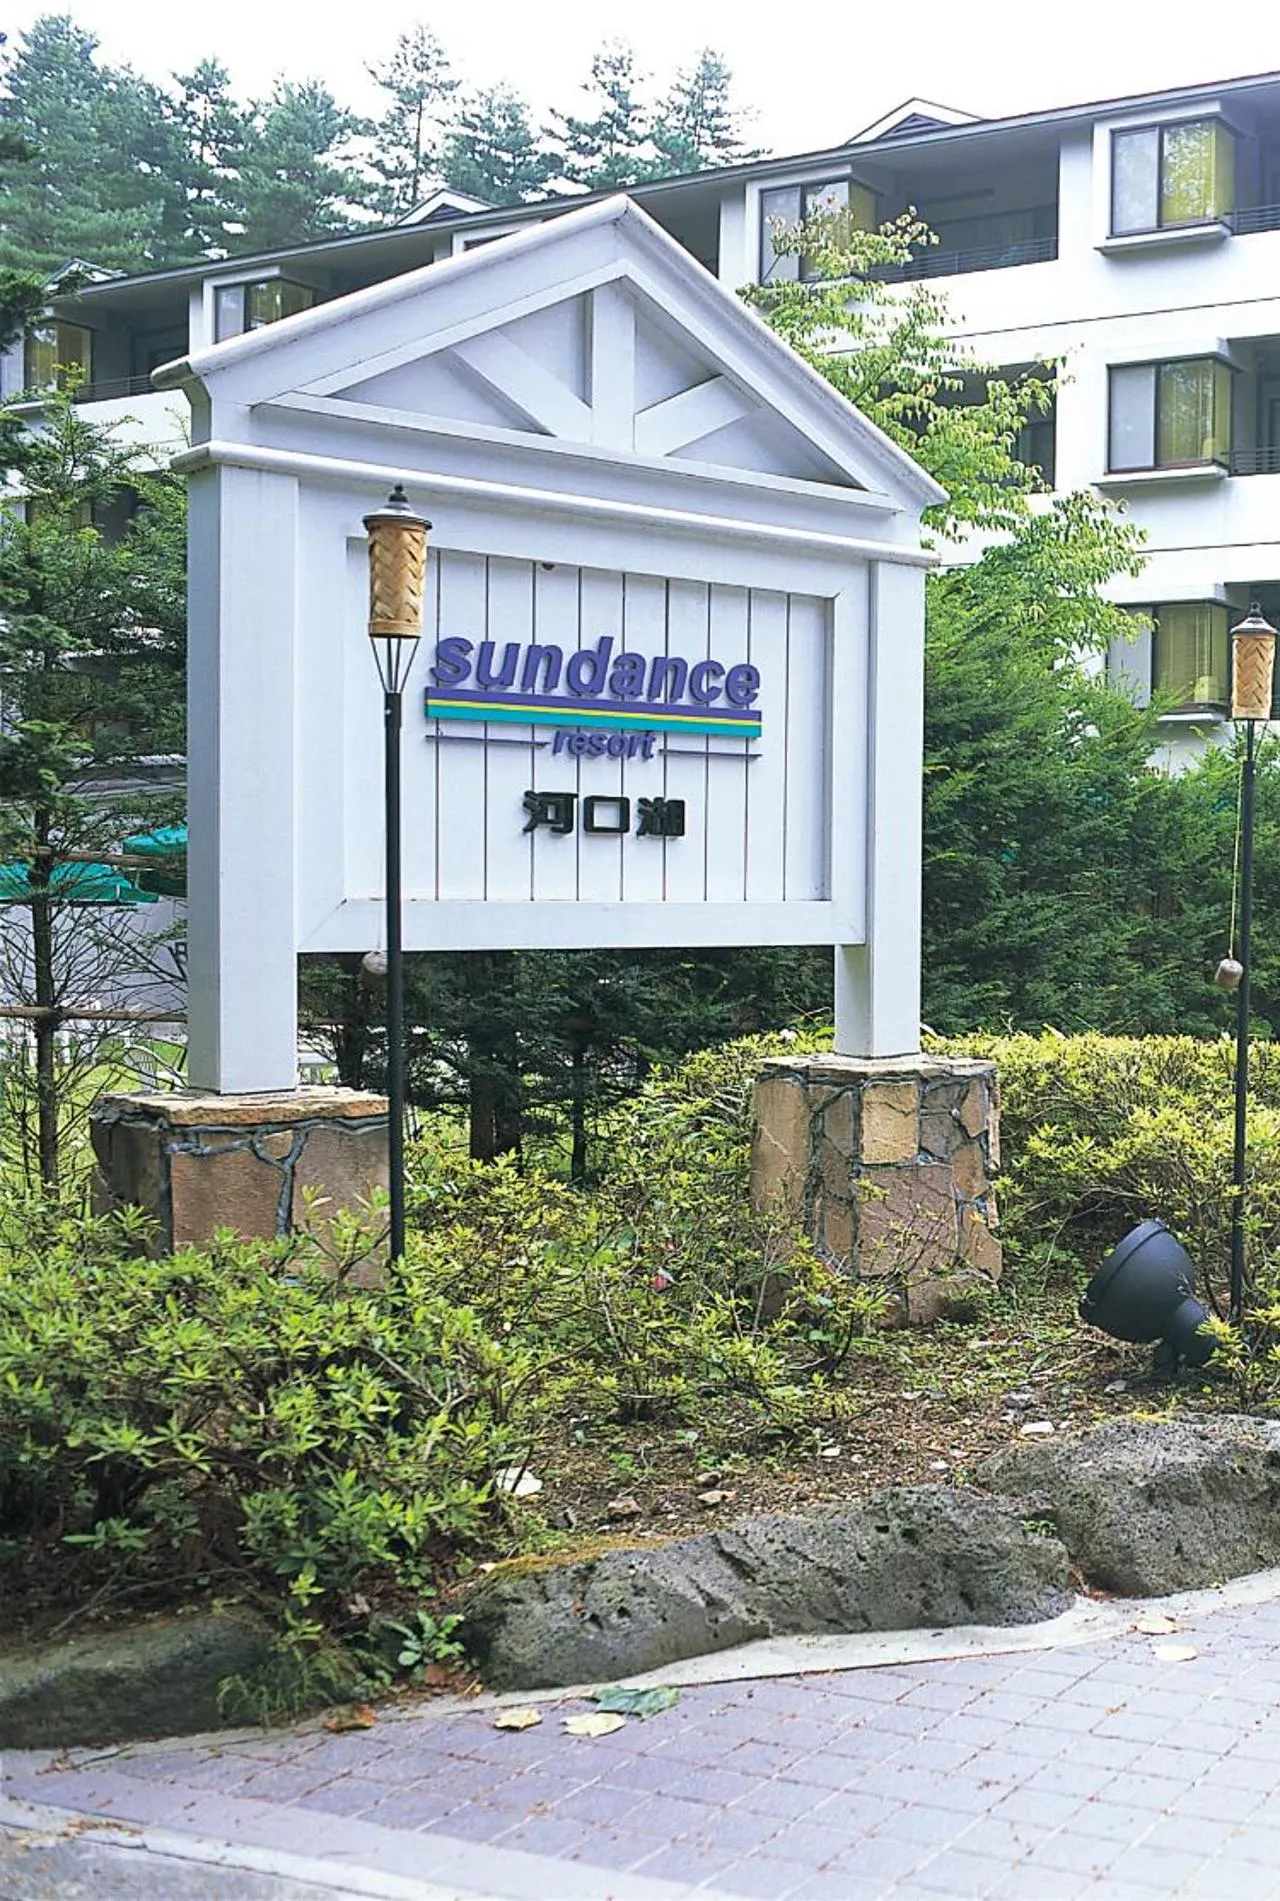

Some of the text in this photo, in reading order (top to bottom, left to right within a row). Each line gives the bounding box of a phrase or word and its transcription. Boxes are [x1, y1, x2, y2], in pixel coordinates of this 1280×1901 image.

[430, 636, 761, 705] sundance
[551, 729, 657, 759] resort
[522, 790, 686, 838] 河口湖
